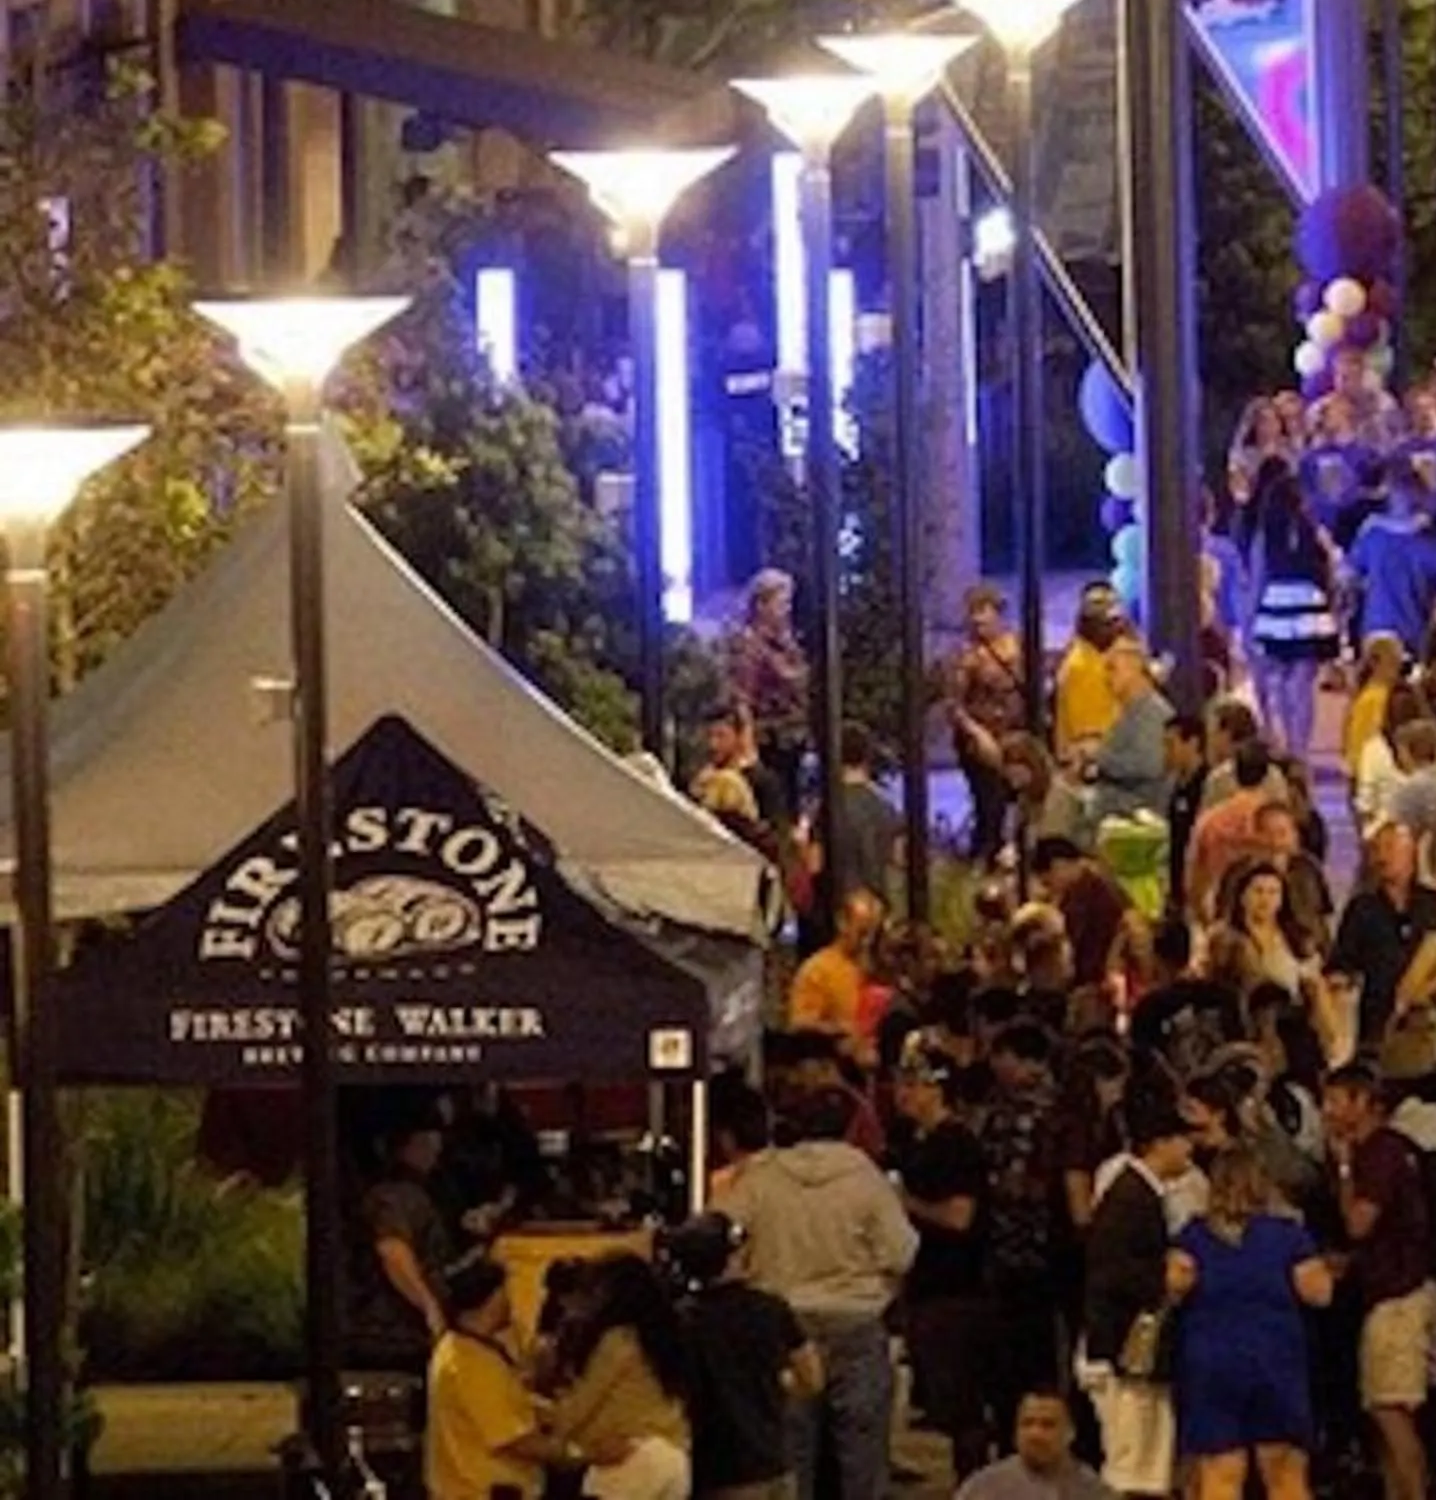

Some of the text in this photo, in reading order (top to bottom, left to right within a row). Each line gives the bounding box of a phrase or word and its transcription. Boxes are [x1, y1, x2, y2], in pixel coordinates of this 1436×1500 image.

[200, 806, 542, 961] FIRSTONE
[170, 1003, 546, 1041] FIRESTNE WALKER
